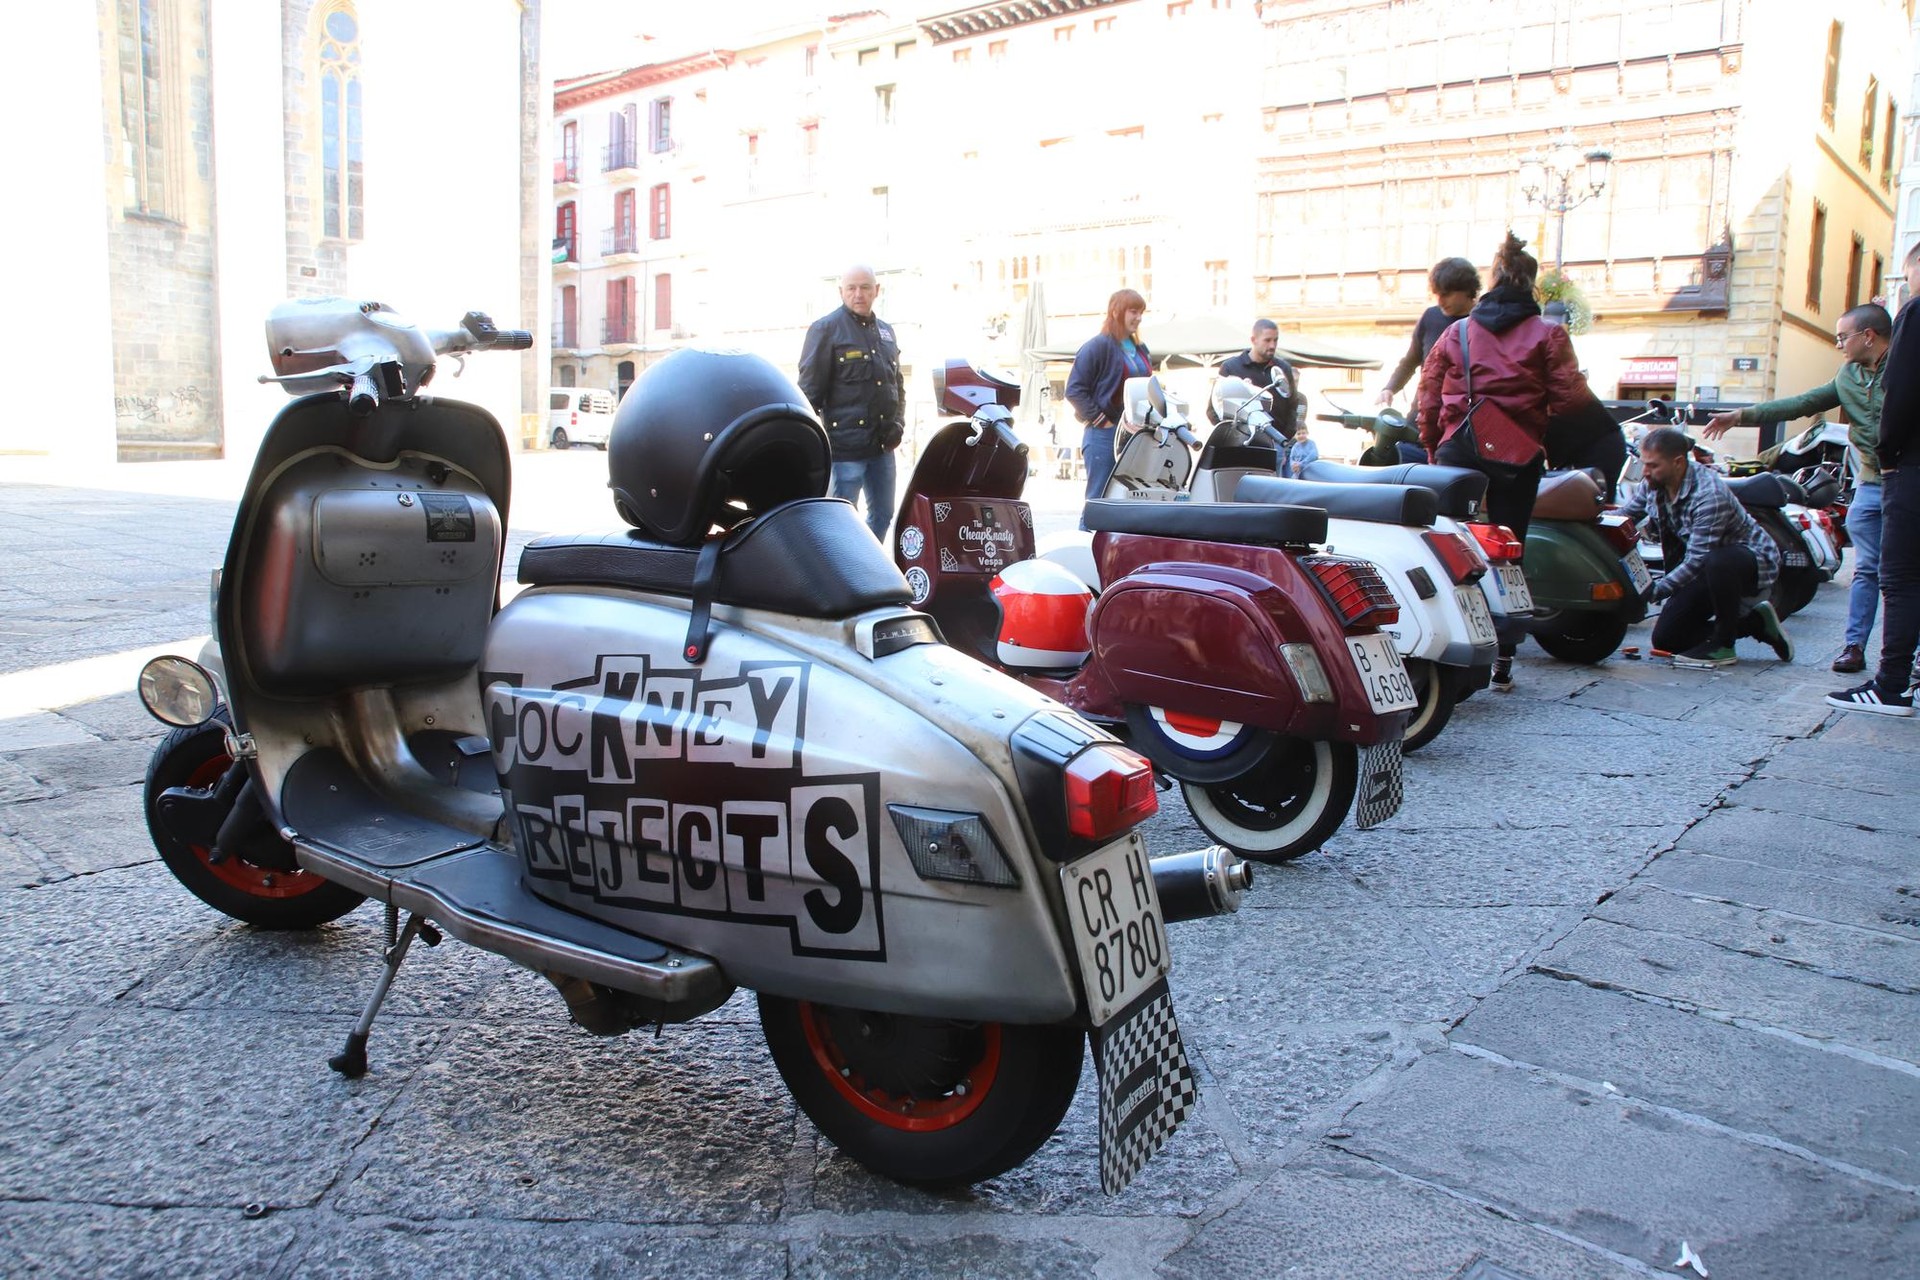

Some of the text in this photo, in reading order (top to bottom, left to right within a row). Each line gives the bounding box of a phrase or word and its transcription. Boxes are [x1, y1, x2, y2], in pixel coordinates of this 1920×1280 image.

[978, 556, 1003, 567] Vespa
[1500, 568, 1524, 587] 7400
[485, 671, 795, 779] COCKNEY
[1370, 672, 1413, 706] 4698
[518, 796, 864, 934] REJECTS
[1078, 849, 1151, 939] CR H
[1094, 910, 1161, 1003] 8780
